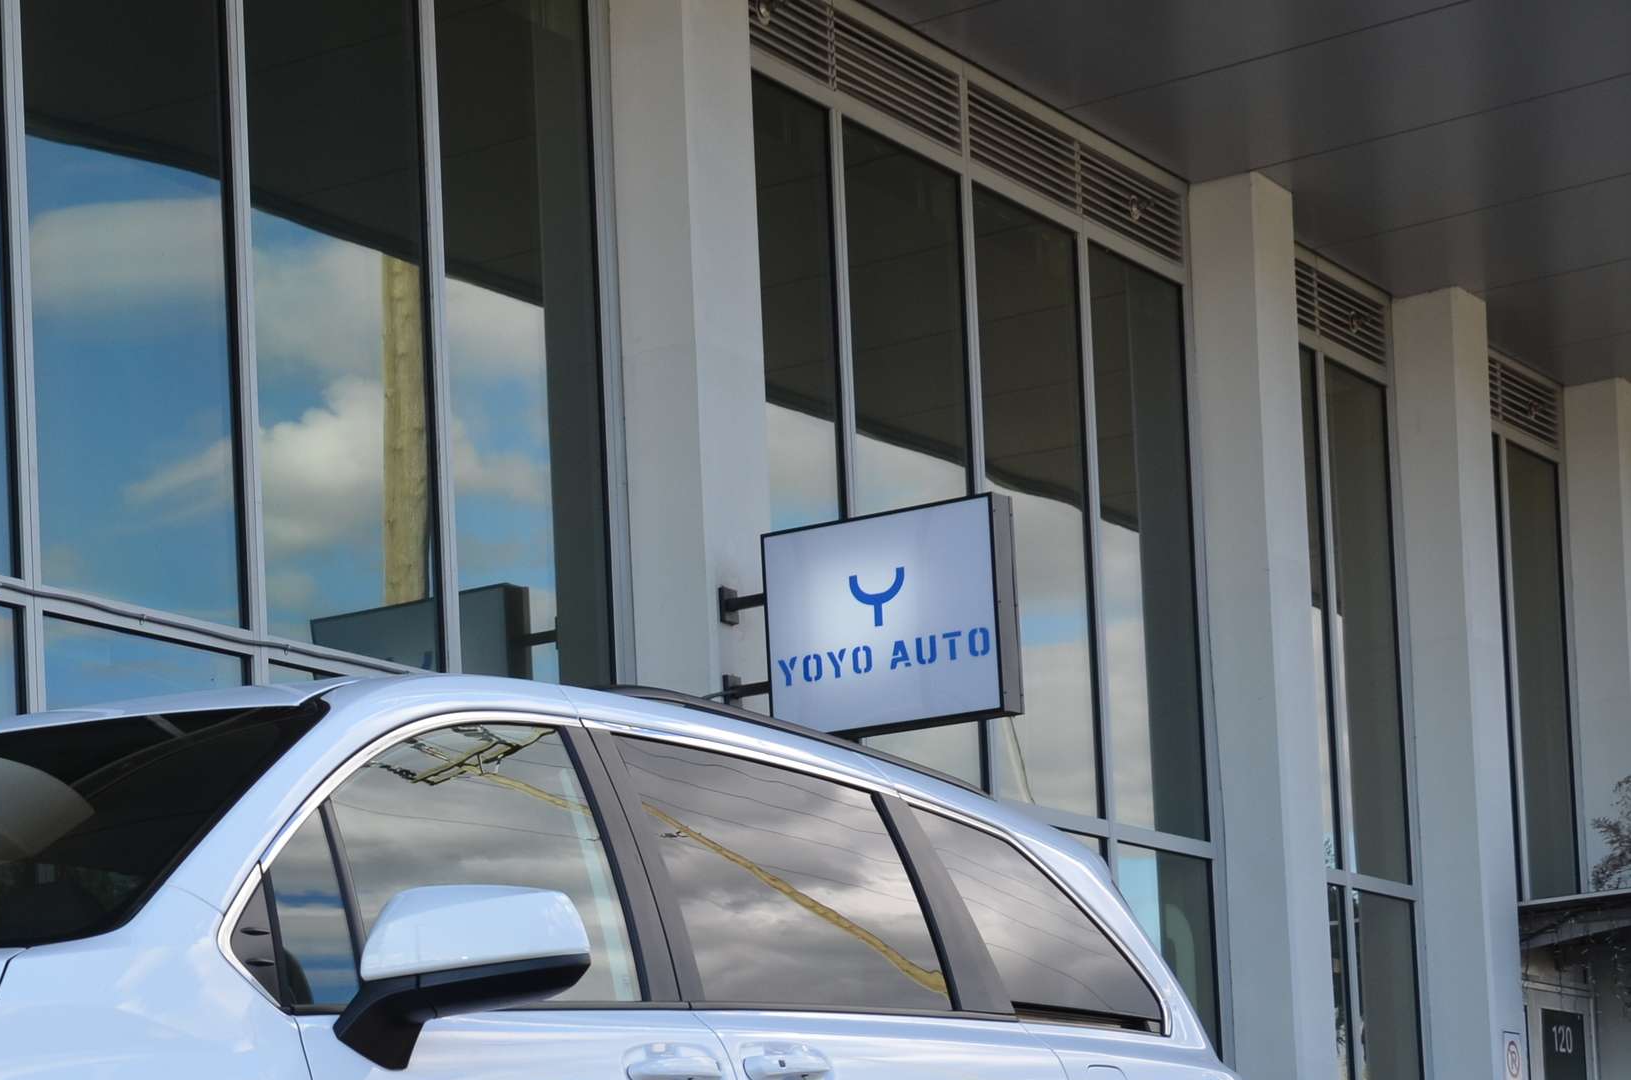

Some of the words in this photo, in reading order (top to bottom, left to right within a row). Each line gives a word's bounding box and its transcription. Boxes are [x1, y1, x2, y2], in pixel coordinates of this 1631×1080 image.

[778, 645, 873, 687] YOYO
[889, 627, 991, 671] AUTO
[1551, 1025, 1574, 1054] 120
